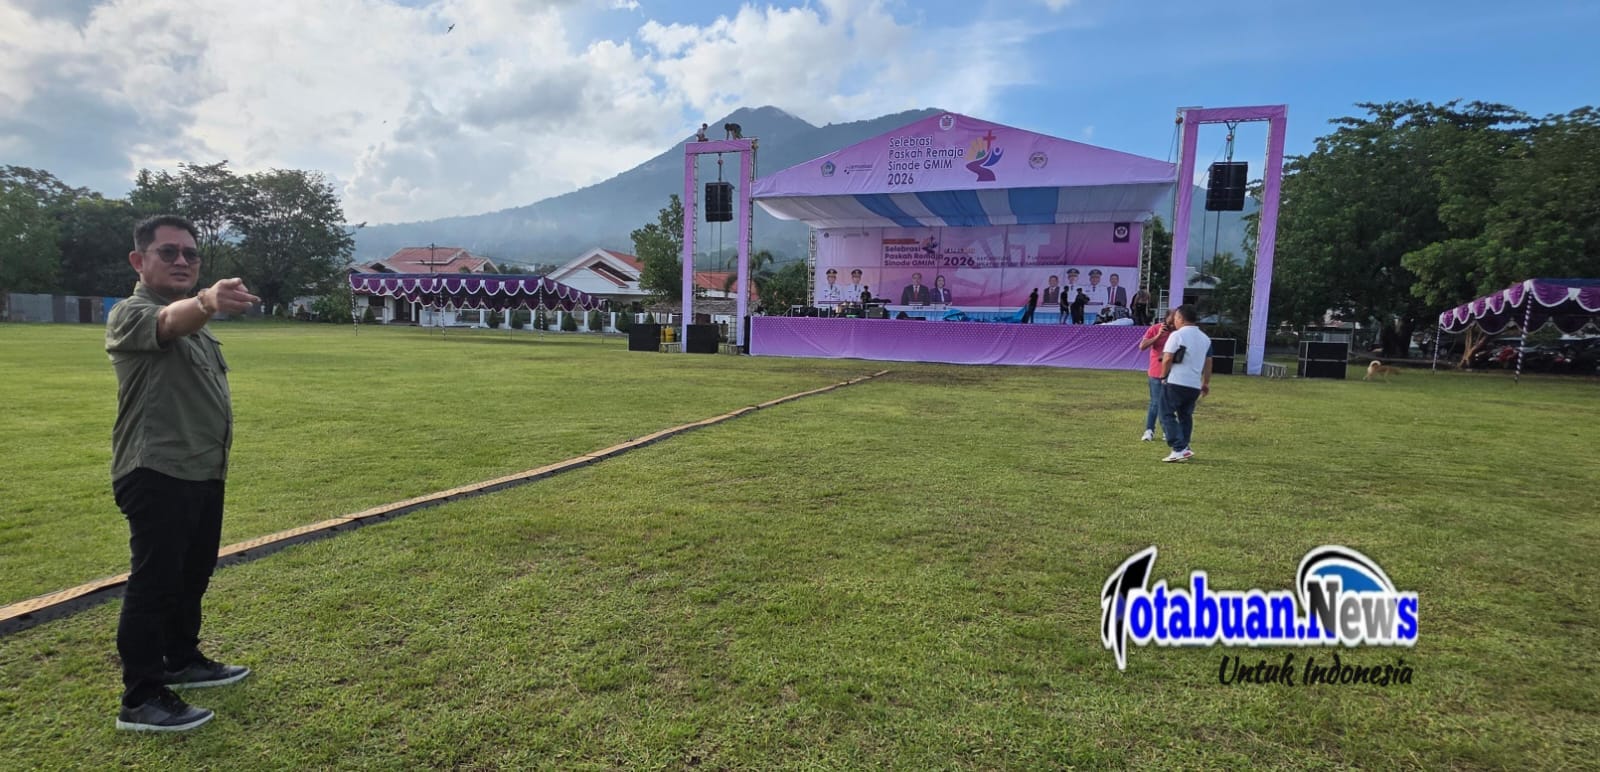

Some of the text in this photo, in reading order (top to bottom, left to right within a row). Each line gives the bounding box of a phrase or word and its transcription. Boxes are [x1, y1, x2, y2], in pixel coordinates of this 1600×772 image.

[889, 136, 933, 147] Selebrasi
[888, 147, 964, 160] Paskah Remaja
[888, 159, 953, 171] Sinode GMIM
[888, 173, 914, 185] 2026
[884, 245, 921, 253] Selebrasi
[913, 252, 944, 261] Remaja
[943, 256, 975, 267] 2026
